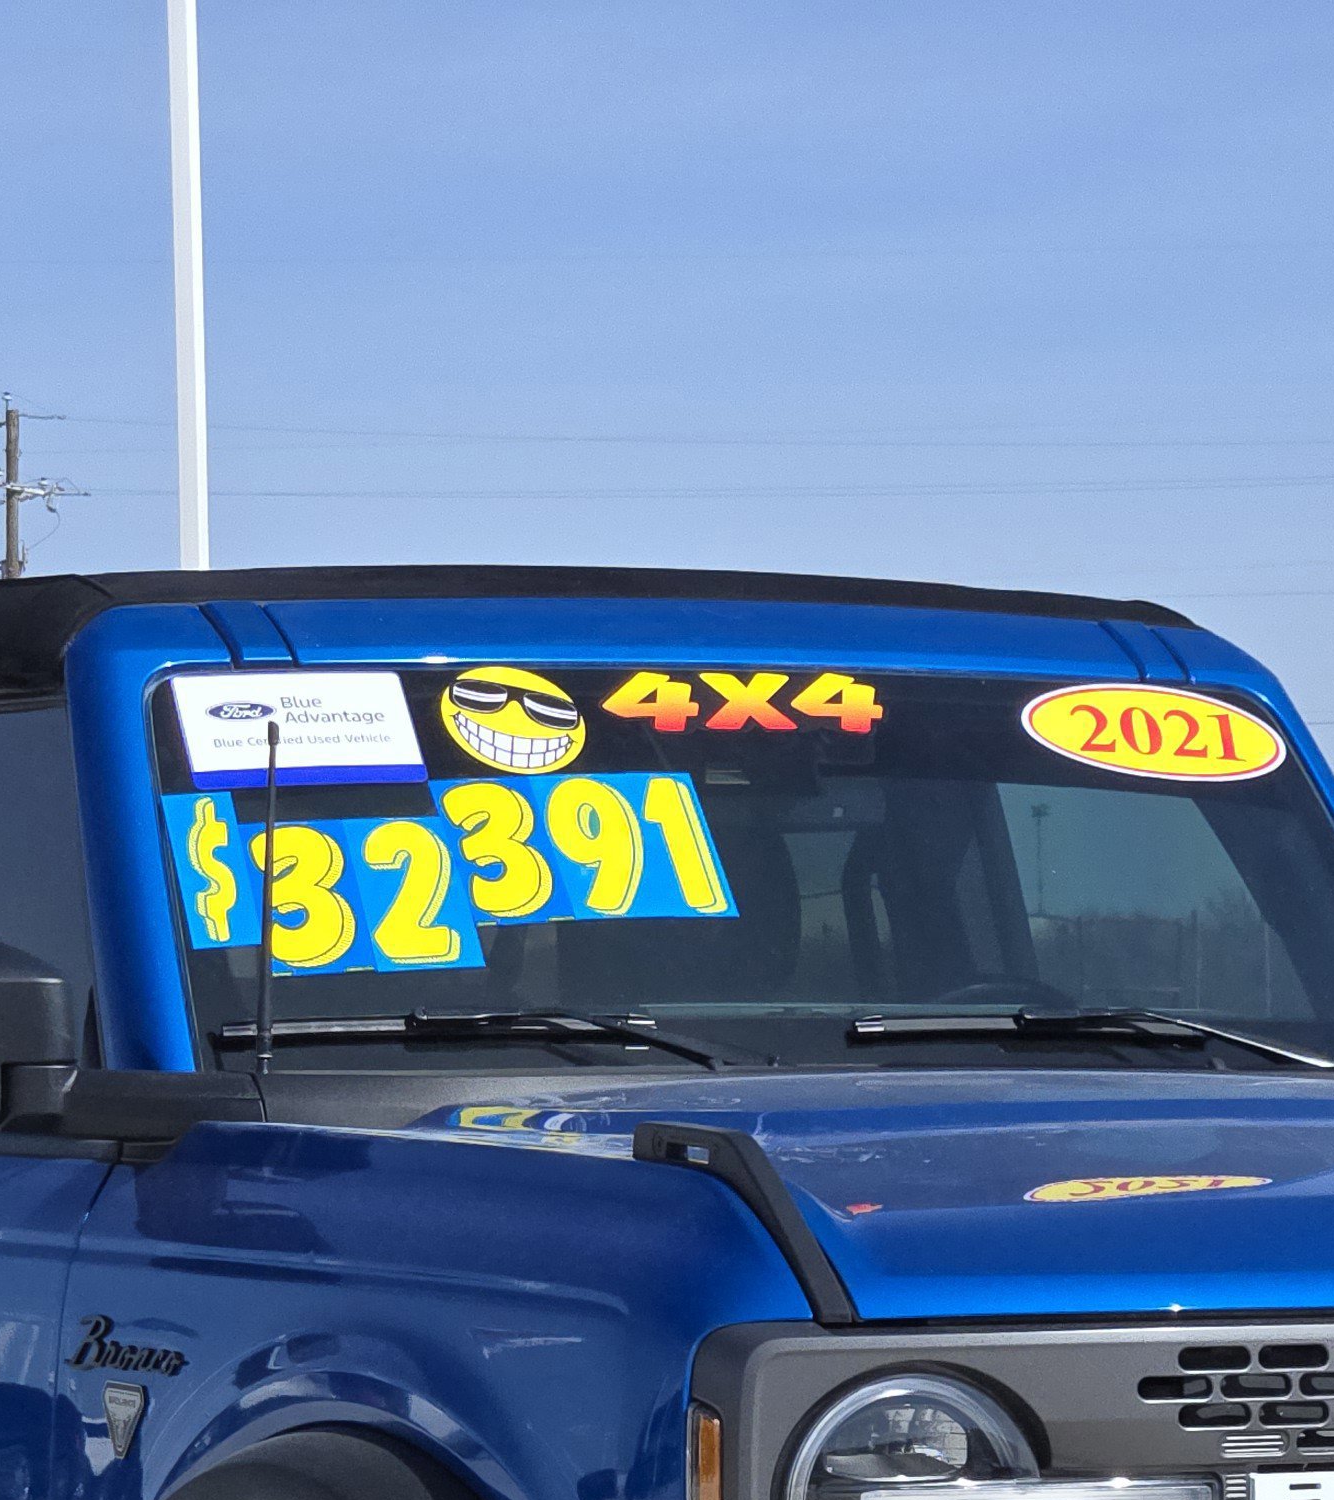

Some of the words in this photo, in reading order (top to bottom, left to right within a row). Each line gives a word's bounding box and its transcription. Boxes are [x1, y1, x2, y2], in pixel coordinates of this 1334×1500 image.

[279, 695, 323, 709] Blue
[284, 710, 386, 726] Advantage
[601, 671, 884, 733] 4X4
[213, 738, 243, 749] Blue
[247, 735, 304, 747] Ceried
[307, 734, 341, 744] Used
[344, 733, 392, 744] Vehicle
[1069, 703, 1248, 763] 2021
[64, 1314, 186, 1377] Bronco
